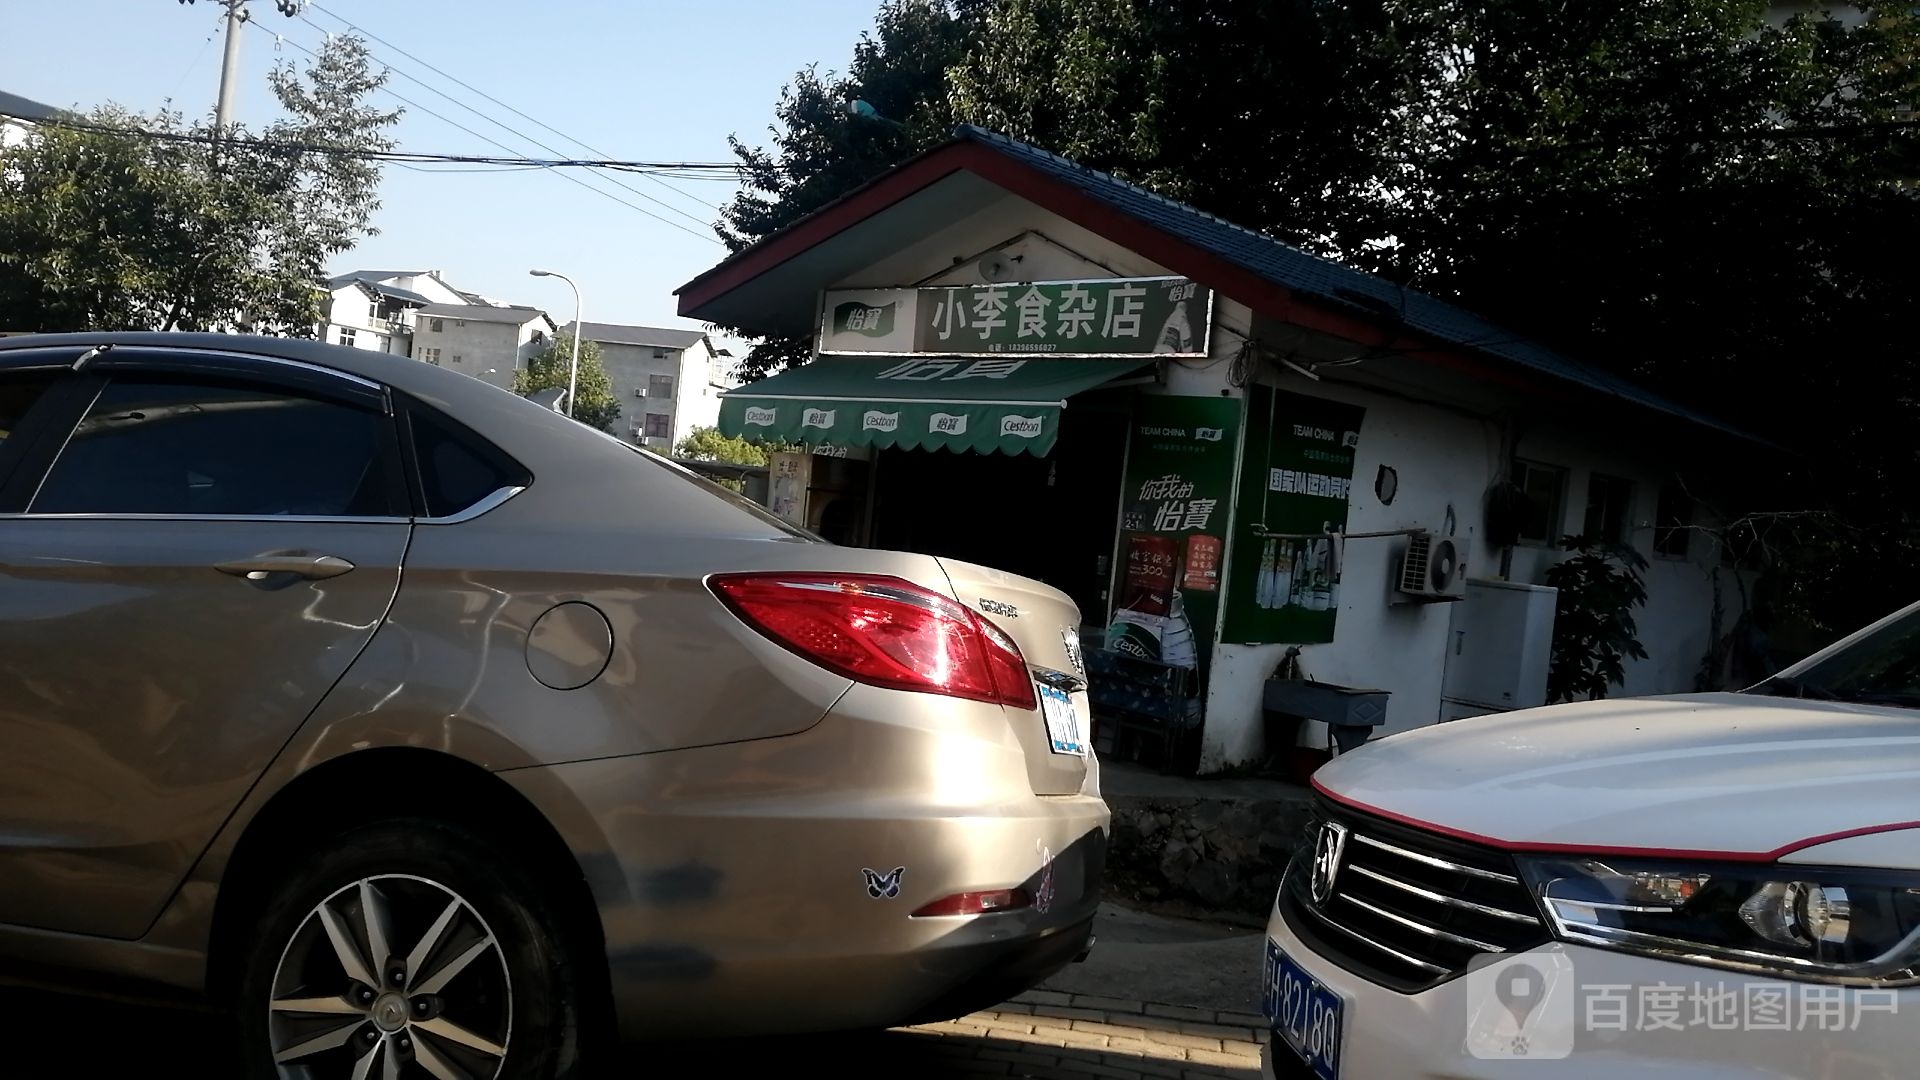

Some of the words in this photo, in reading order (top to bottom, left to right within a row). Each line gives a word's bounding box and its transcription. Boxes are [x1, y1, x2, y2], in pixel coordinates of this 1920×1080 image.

[846, 307, 883, 331] 怡寶
[930, 282, 1148, 341] 小李食杂店
[866, 415, 897, 428] Cestbon
[1004, 419, 1040, 433] Cestbon
[1140, 425, 1161, 436] TEAM
[1162, 427, 1186, 438] CHINA
[1292, 424, 1313, 438] TEAM
[1314, 428, 1335, 442] CHINA
[1138, 473, 1195, 501] 你我的
[1152, 497, 1217, 532] 怡寶
[1141, 563, 1163, 576] 300
